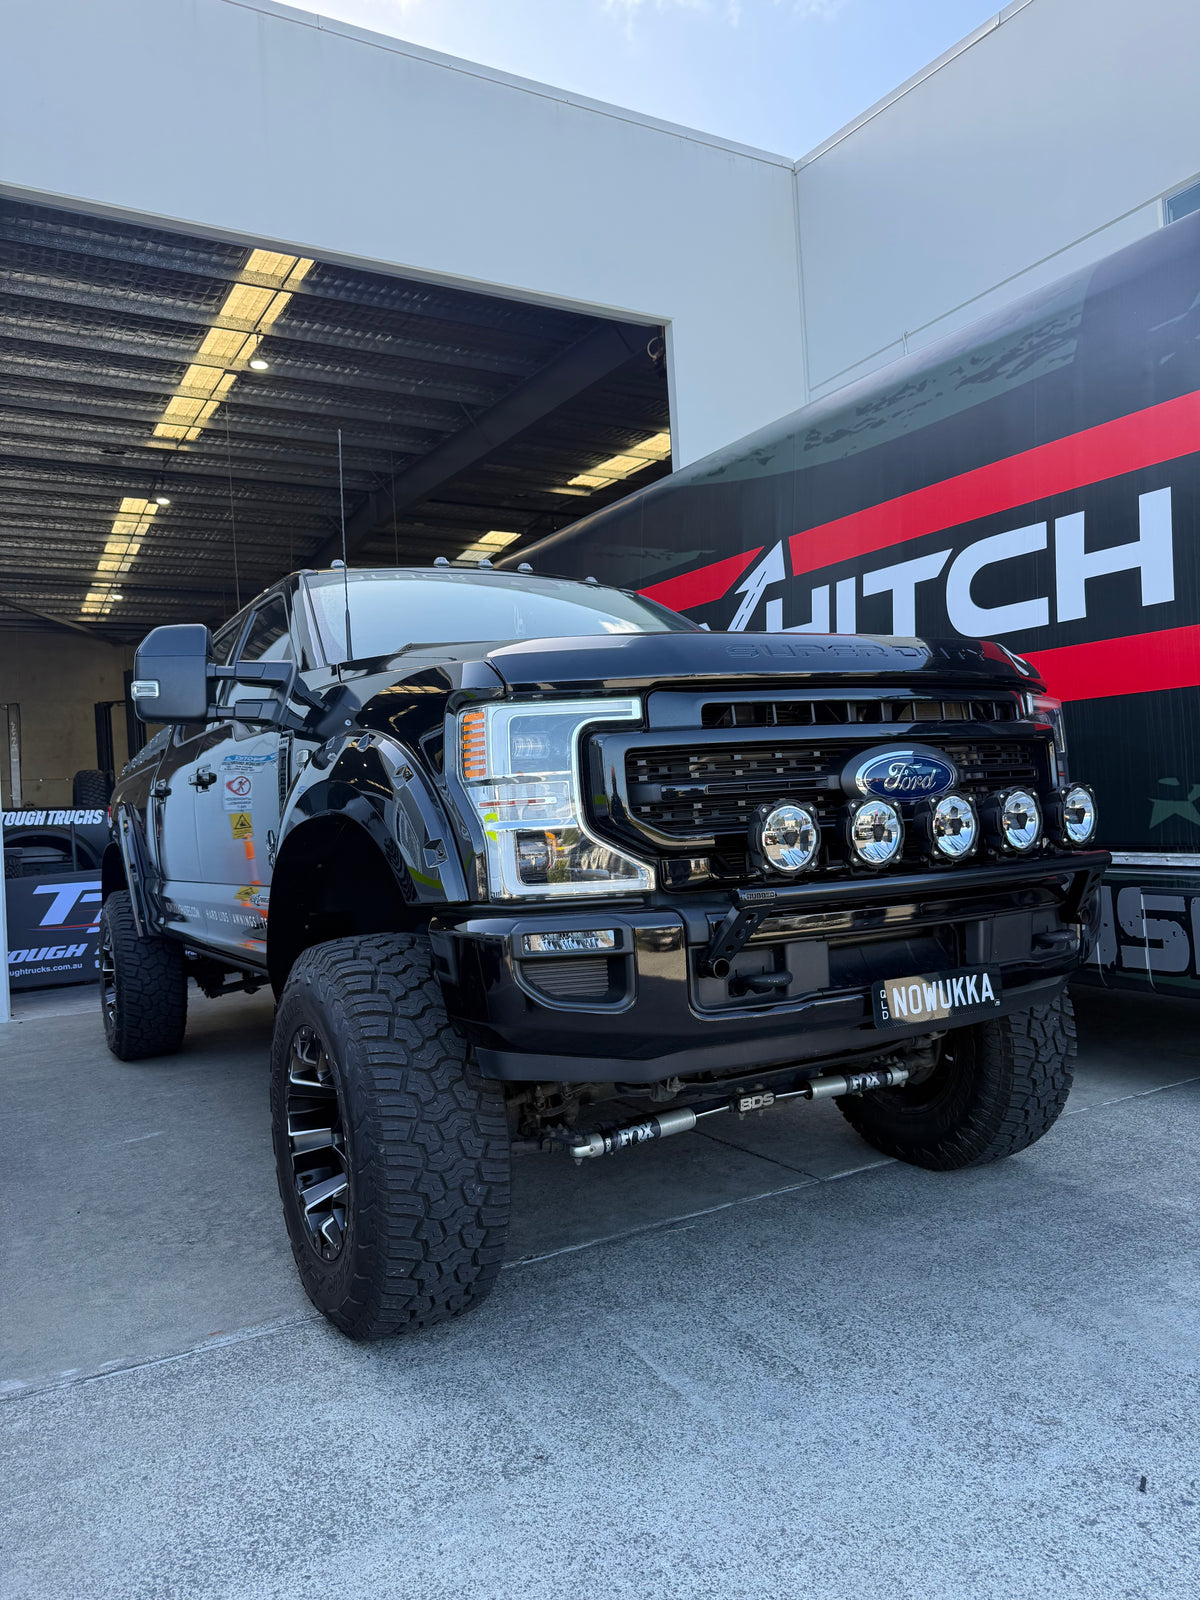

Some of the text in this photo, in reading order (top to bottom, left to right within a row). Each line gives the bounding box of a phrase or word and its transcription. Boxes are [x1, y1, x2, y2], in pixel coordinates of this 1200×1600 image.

[726, 643, 888, 658] SUPER
[883, 762, 937, 792] Ford
[48, 809, 104, 825] TRUCKS
[8, 943, 89, 964] OUGH
[9, 963, 83, 977] ughtrucks.com.au
[879, 989, 889, 1020] QLD
[892, 972, 995, 1018] NOWUKKA
[739, 1092, 775, 1113] BDS
[618, 1122, 655, 1146] FOX
